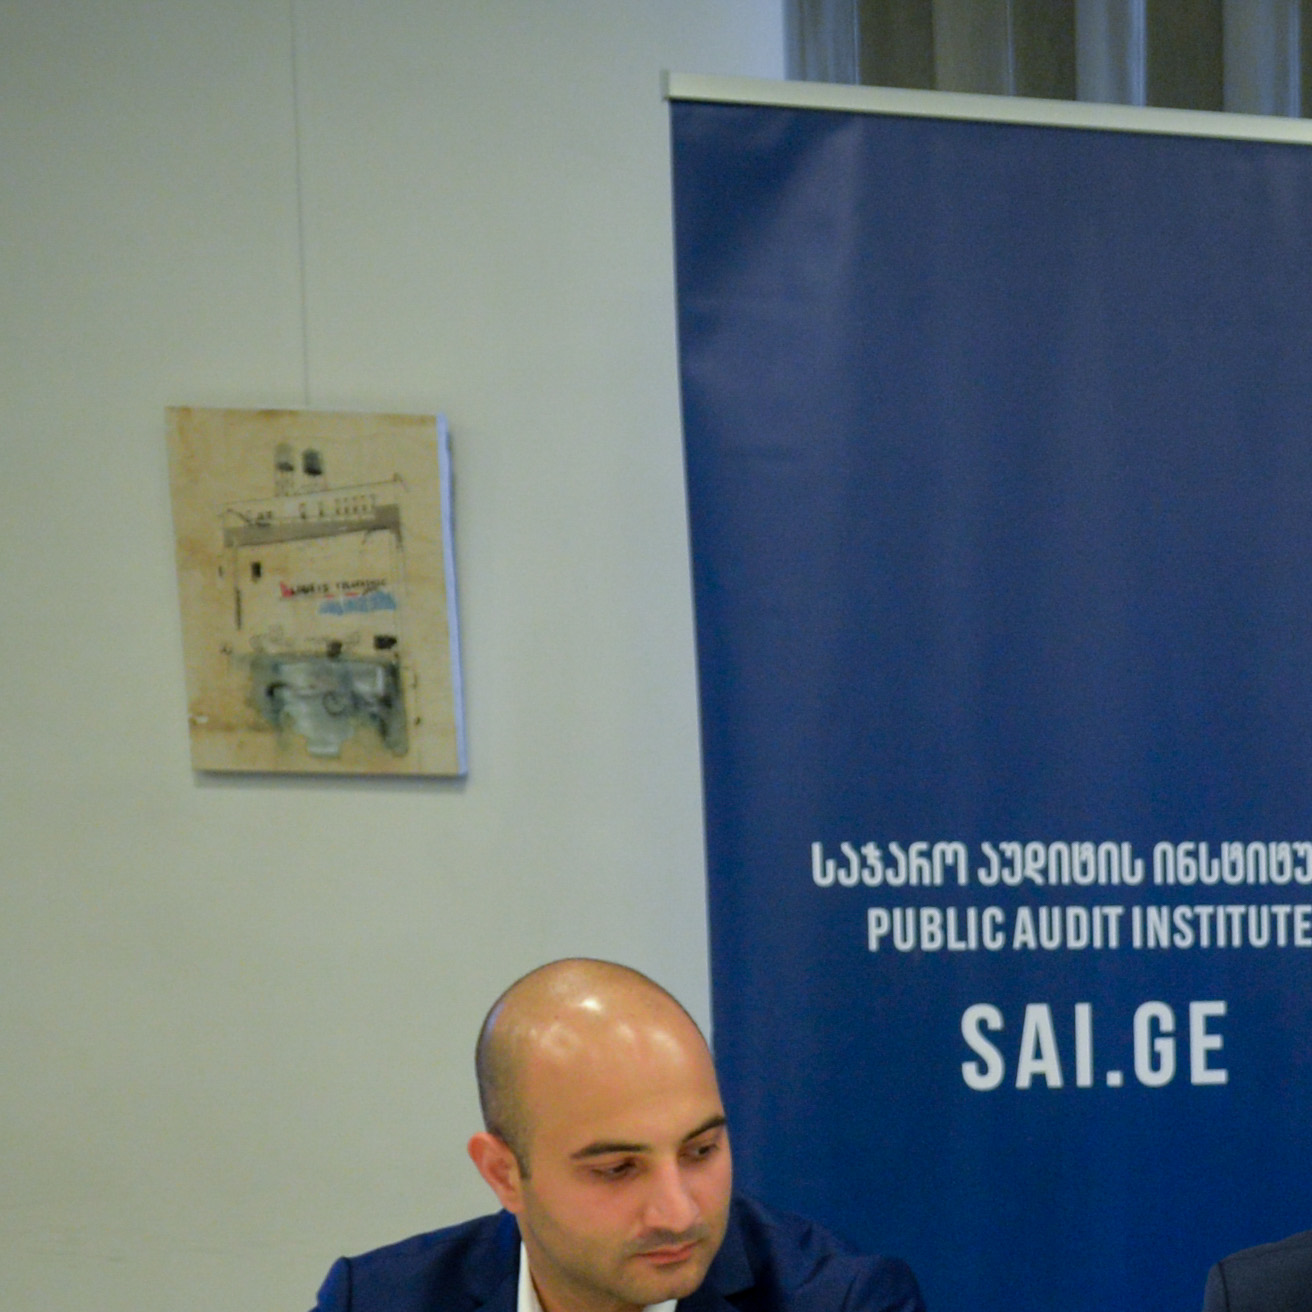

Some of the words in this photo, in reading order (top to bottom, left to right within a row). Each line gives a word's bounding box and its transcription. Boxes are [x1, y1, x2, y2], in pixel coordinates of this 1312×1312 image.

[811, 842, 968, 887] საჯარო
[977, 842, 1144, 887] აუდიტის
[867, 907, 1005, 952] PUBLIC
[1013, 906, 1124, 951] AUDIT
[960, 1001, 1228, 1091] SAI.GE
